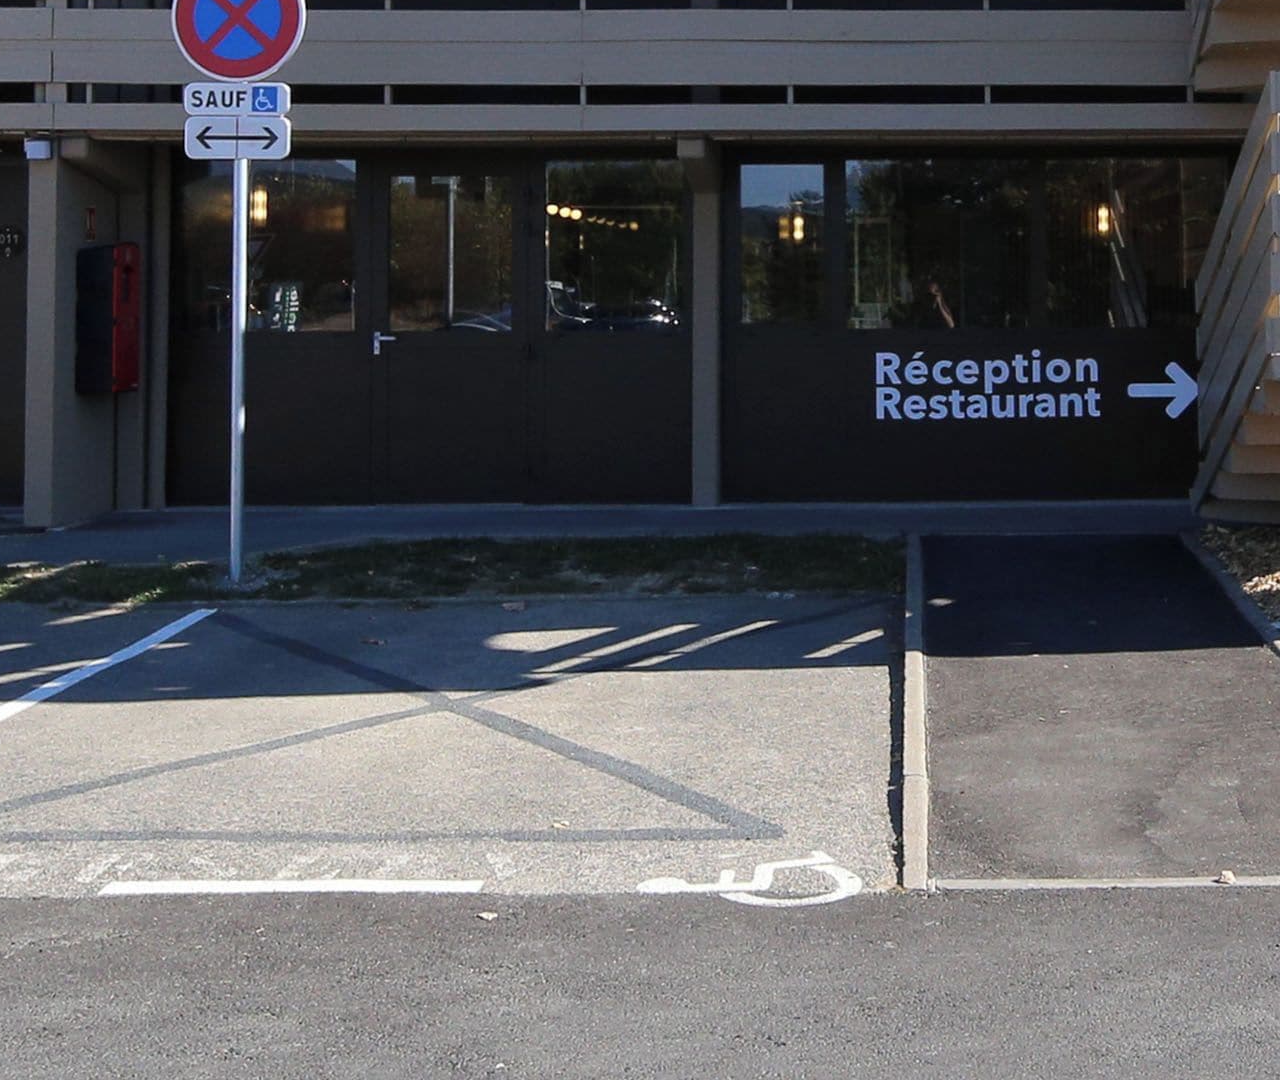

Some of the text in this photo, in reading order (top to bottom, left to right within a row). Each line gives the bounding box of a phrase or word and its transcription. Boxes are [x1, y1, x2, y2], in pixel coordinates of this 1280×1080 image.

[191, 90, 247, 108] SAUF
[875, 349, 1100, 394] Réception
[875, 386, 1101, 421] Restaurant
